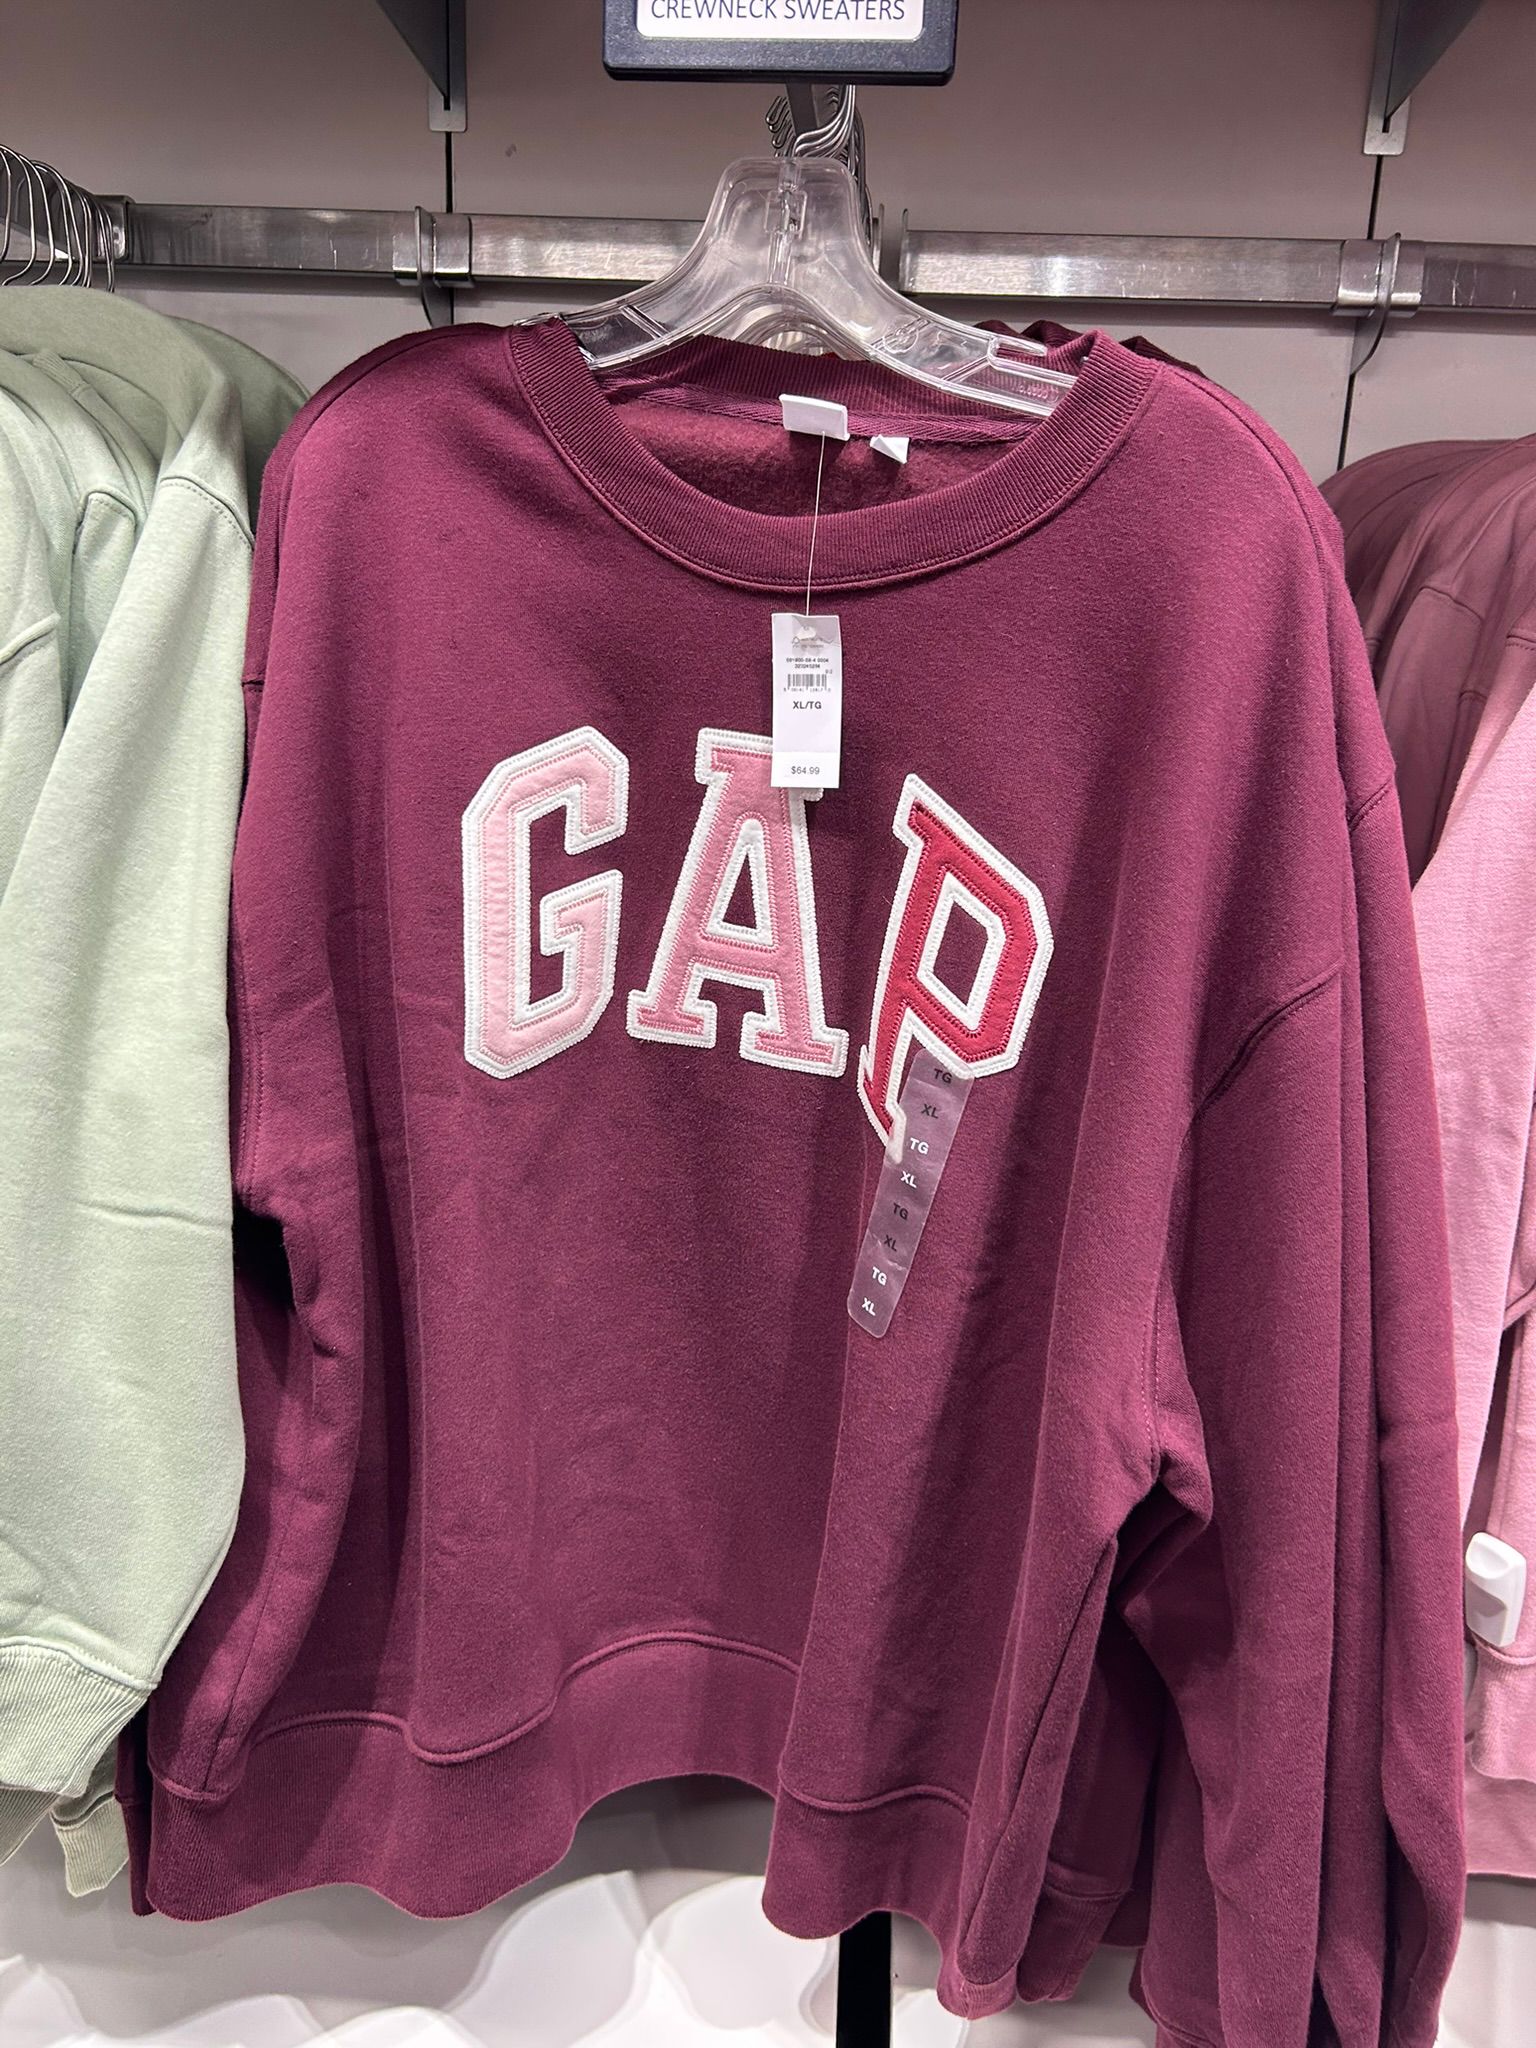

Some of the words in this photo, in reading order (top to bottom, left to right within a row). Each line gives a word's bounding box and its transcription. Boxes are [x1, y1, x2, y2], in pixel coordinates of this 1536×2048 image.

[651, 0, 777, 19] CREWNECK
[784, 0, 905, 20] SWEATERS
[792, 701, 822, 710] XL/TG
[791, 766, 820, 775] $64.99
[462, 726, 1054, 1164] GAP
[933, 1067, 952, 1084] TG
[921, 1103, 939, 1119] XL
[909, 1137, 929, 1155] TG
[900, 1171, 917, 1188] XL
[892, 1202, 908, 1221] TG
[883, 1235, 898, 1252] XL
[871, 1266, 887, 1286] TG
[861, 1298, 876, 1316] XL
